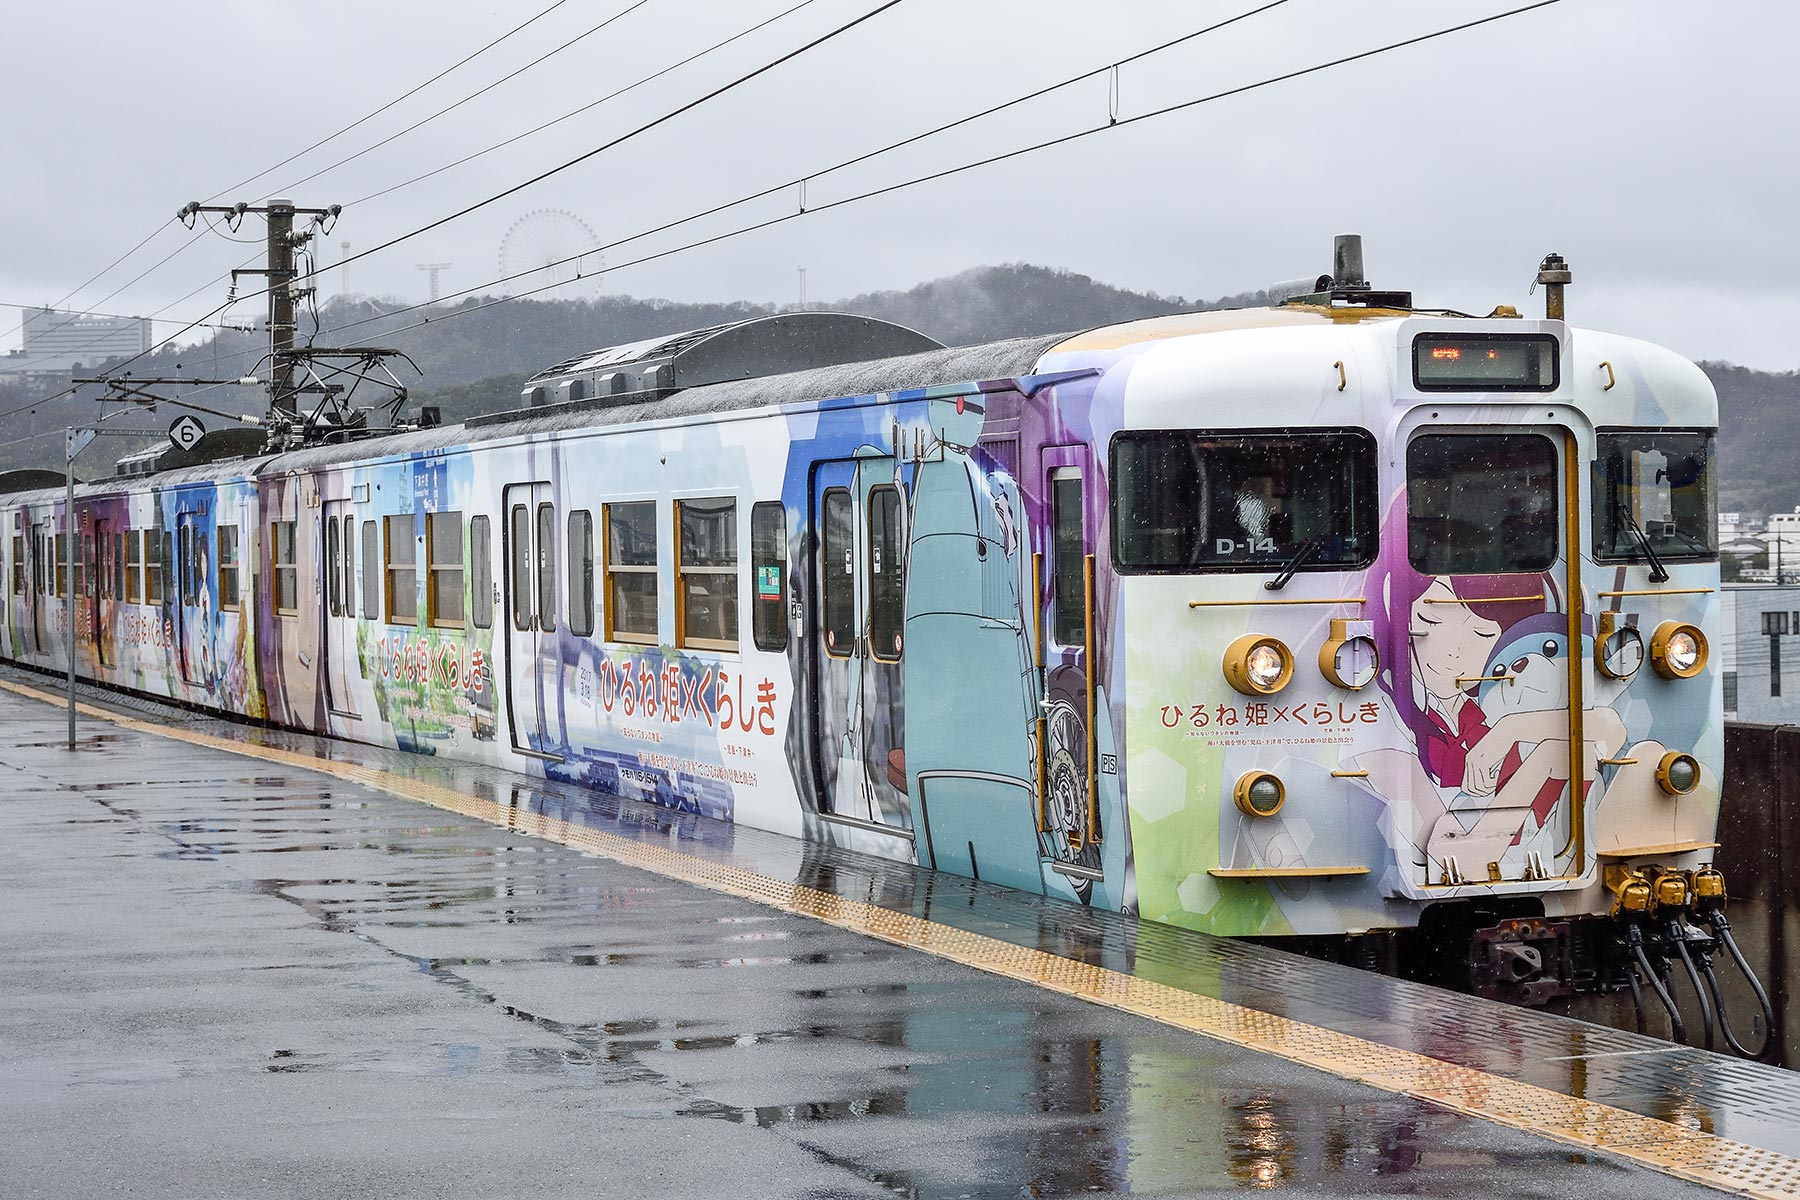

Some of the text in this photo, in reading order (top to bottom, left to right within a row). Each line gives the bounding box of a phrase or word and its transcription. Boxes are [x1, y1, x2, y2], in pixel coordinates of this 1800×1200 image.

[181, 425, 194, 443] 6
[1216, 537, 1277, 555] D-14
[381, 636, 483, 692] ひるね姫×くらしき
[601, 660, 777, 736] ひるね姫×くらしき
[1160, 702, 1380, 728] ひるね姫×くらしき
